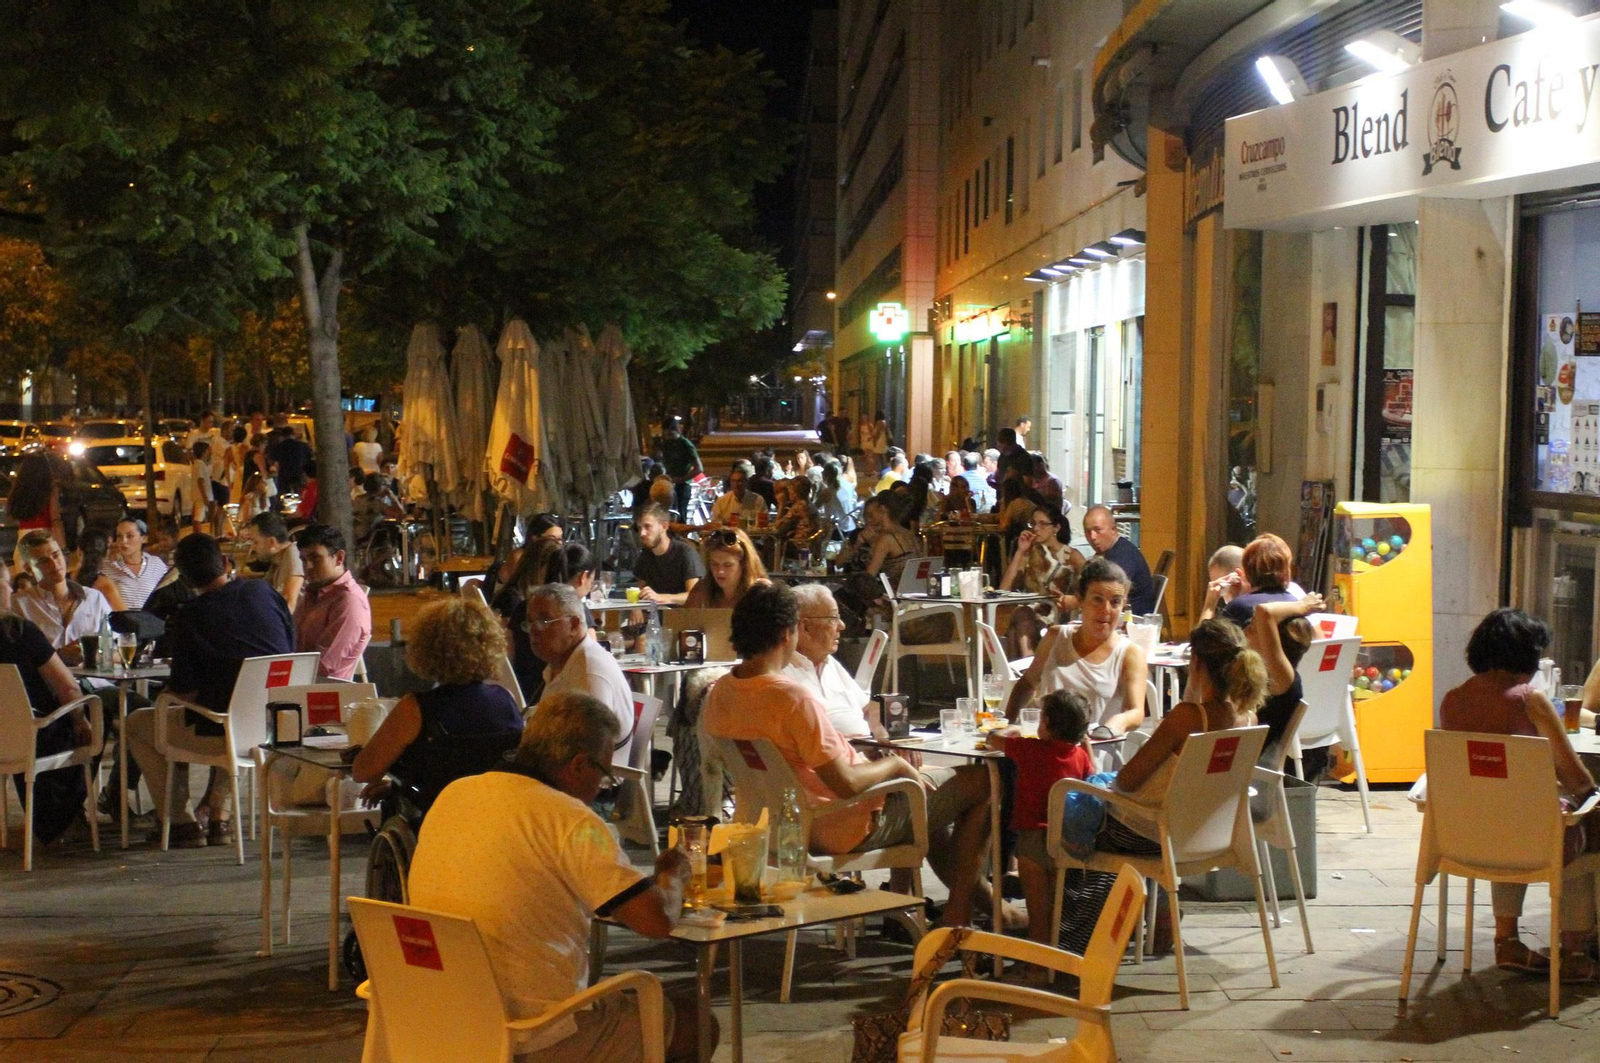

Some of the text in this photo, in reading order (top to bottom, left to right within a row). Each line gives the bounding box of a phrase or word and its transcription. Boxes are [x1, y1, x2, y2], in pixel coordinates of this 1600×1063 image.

[1332, 88, 1409, 165] Blend
[1576, 64, 1600, 133] y
[1241, 136, 1286, 165] Cruzcampo
